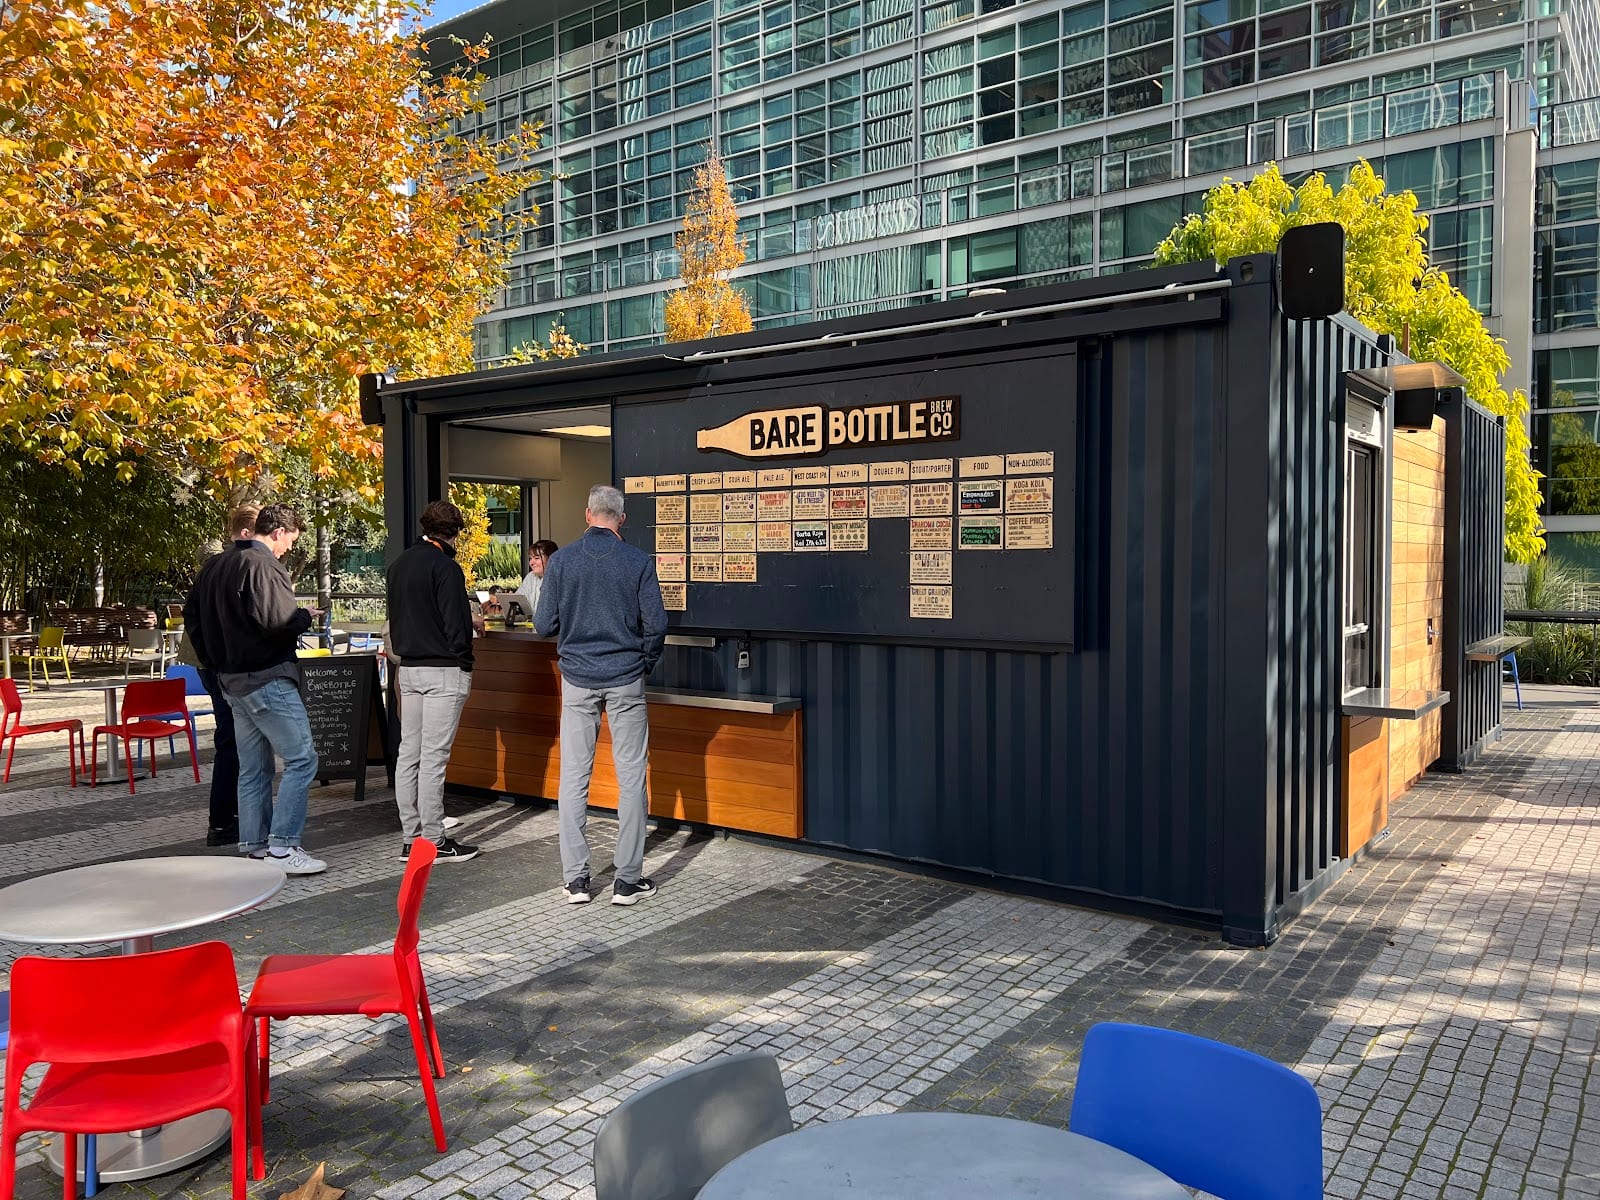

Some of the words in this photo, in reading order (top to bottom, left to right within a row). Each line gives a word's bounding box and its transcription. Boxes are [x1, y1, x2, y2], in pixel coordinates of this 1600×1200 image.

[930, 400, 952, 414] BREW
[750, 413, 816, 450] BARE
[828, 402, 927, 446] BOTTLE
[930, 412, 952, 436] CO
[973, 462, 989, 470] FOOD
[1008, 458, 1052, 468] NON-ALCOHOLIC
[874, 468, 893, 476] DOUBLE
[912, 464, 952, 474] STOUT/PORTER
[742, 475, 750, 483] ALE
[806, 472, 818, 480] COAST
[1008, 517, 1028, 525] COFFEE
[1029, 516, 1049, 524] PRICES
[304, 669, 338, 677] Welcome
